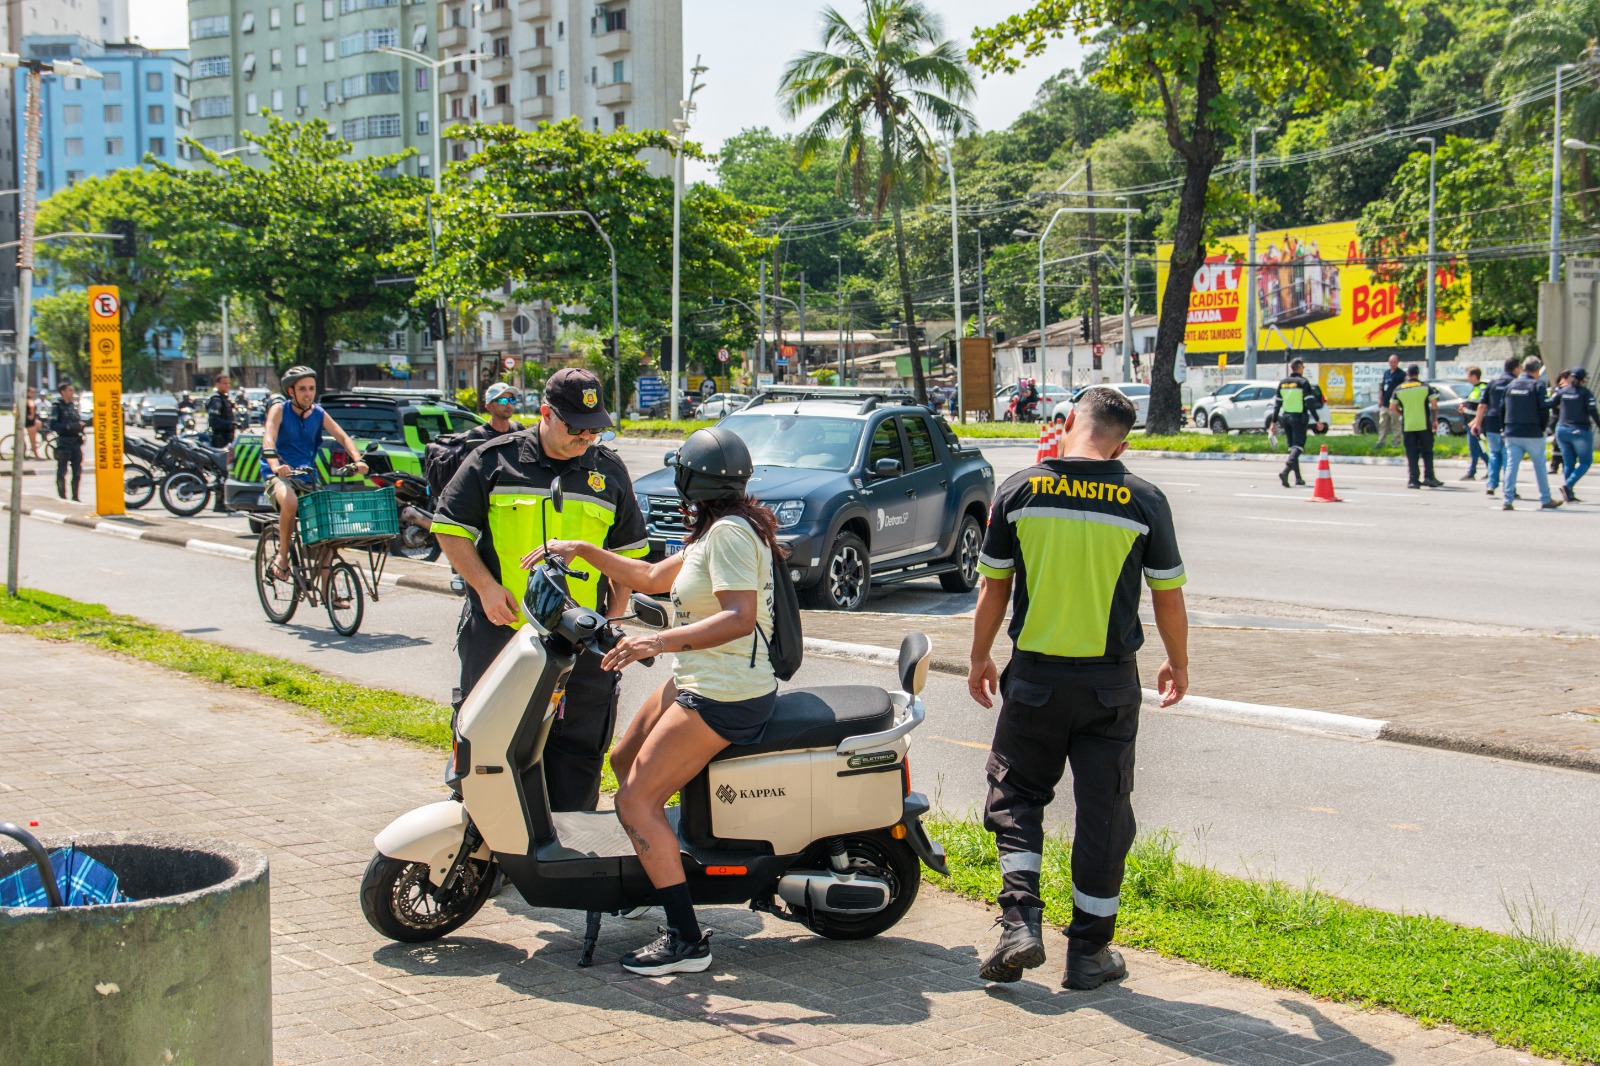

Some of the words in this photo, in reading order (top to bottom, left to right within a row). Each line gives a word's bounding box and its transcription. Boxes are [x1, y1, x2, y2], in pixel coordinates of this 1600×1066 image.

[1193, 254, 1238, 292] ort
[1190, 291, 1239, 308] CADISTA
[98, 410, 108, 469] EMBARQUE
[111, 389, 121, 469] DESEMBARQUE
[1028, 474, 1132, 505] TRÂNSITO
[740, 787, 786, 799] KAPPAK
